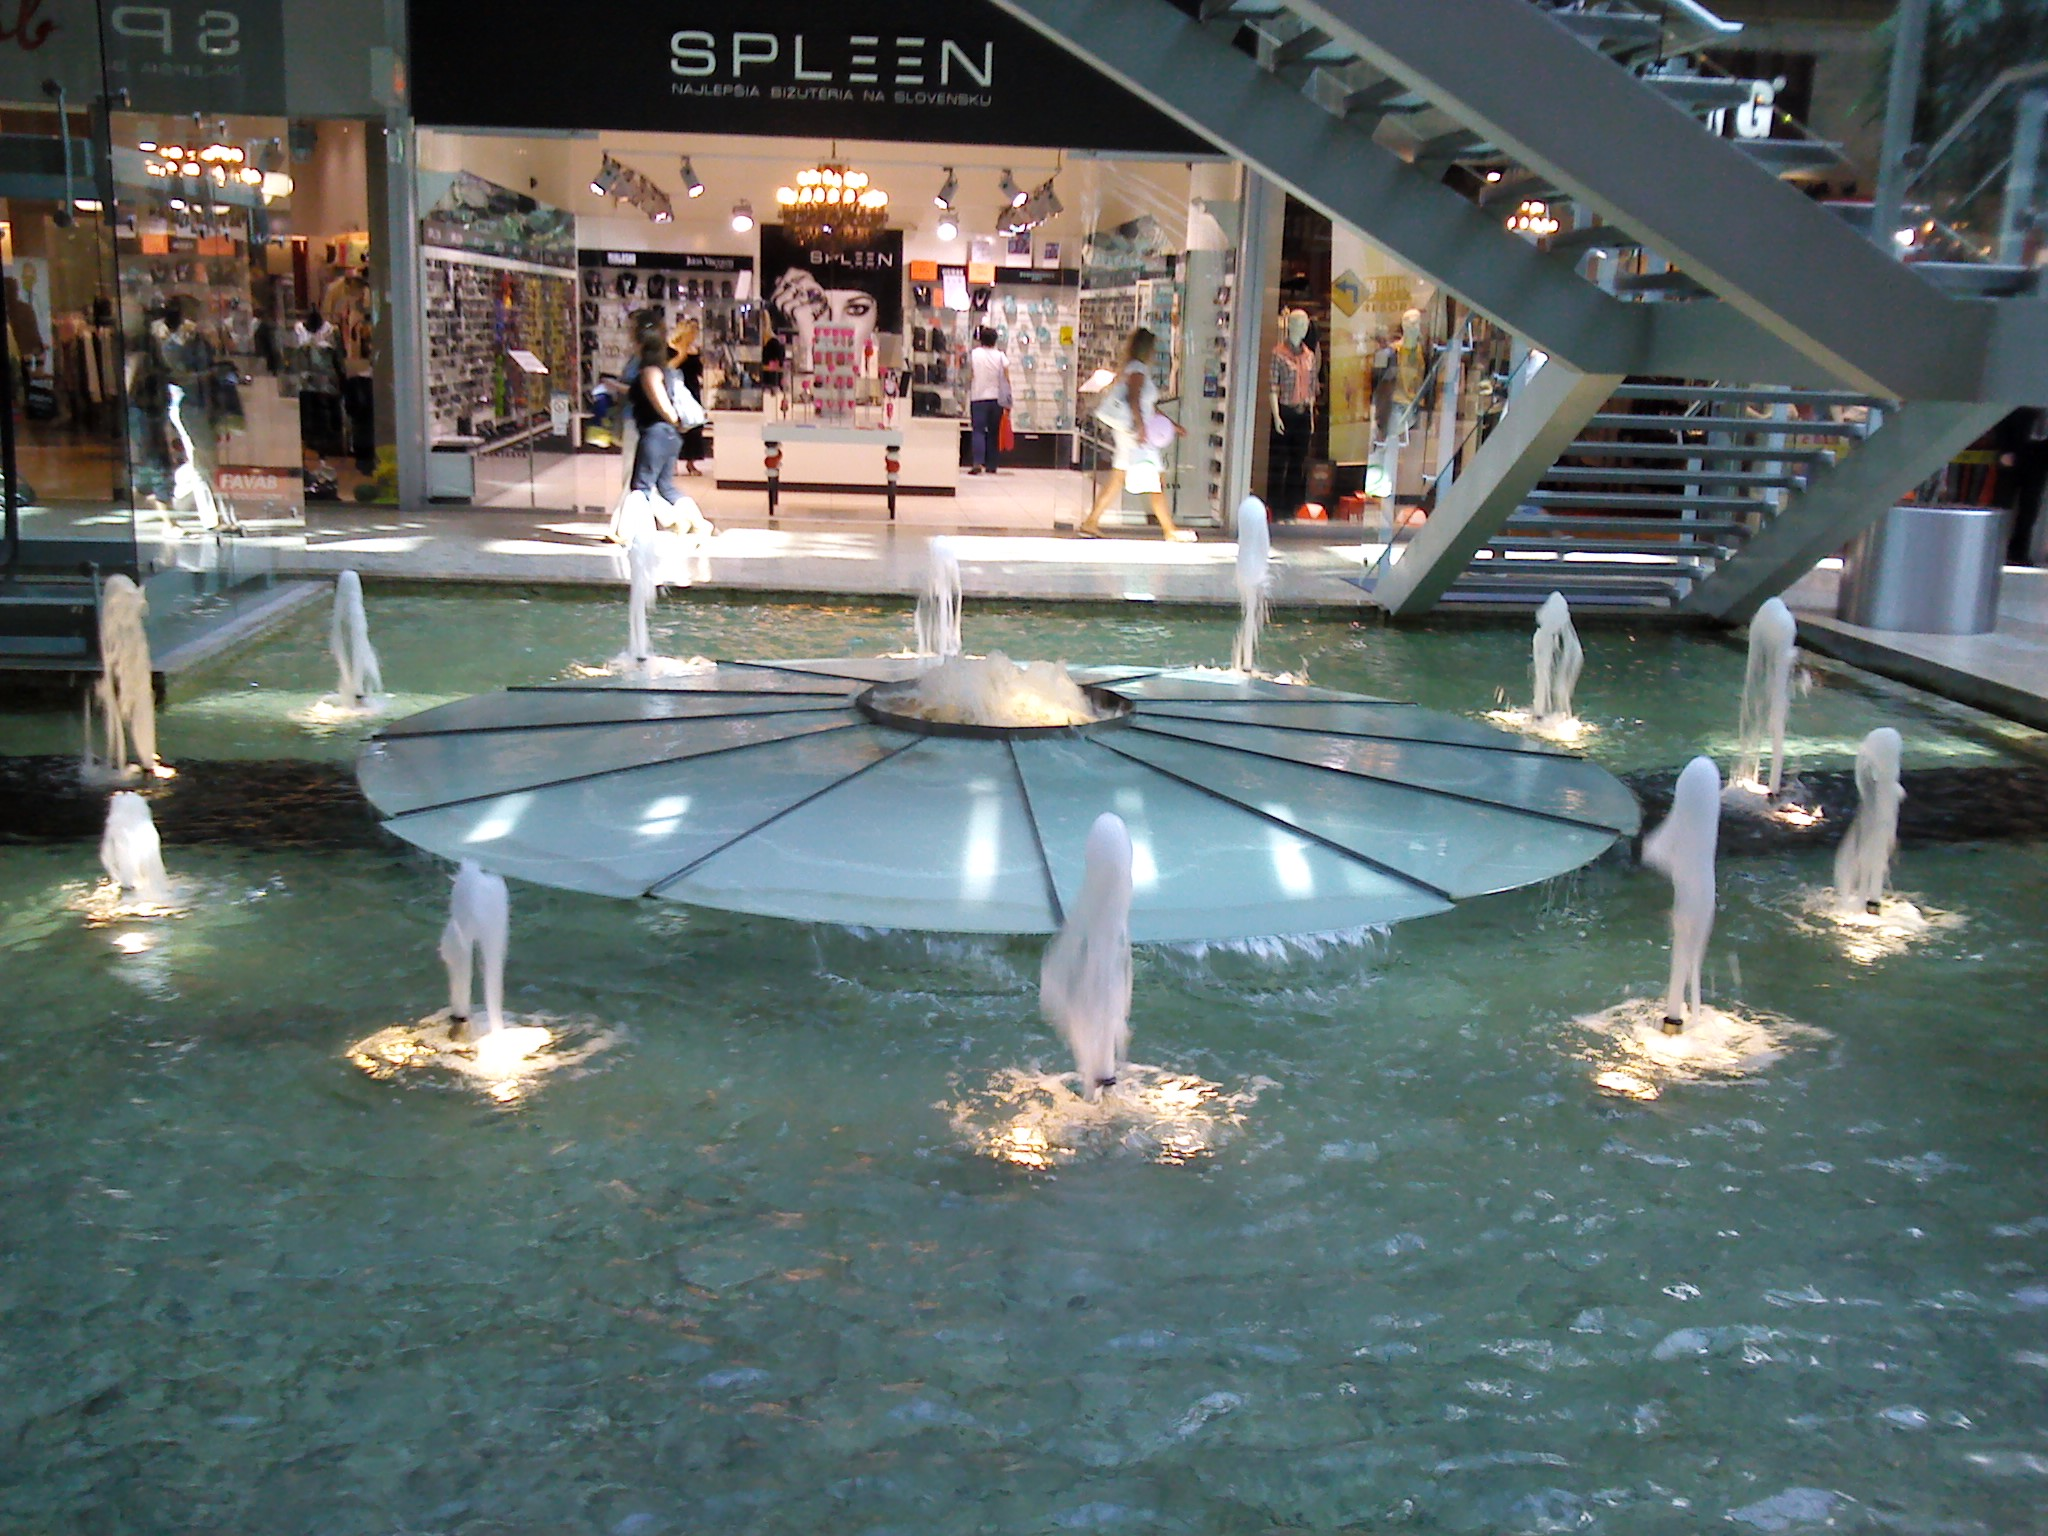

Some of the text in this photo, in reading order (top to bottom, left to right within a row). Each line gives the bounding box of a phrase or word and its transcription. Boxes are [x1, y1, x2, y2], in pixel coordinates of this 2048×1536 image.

[670, 30, 993, 87] SPLEEN
[863, 89, 885, 102] NA
[894, 90, 992, 107] SLOVENSKU
